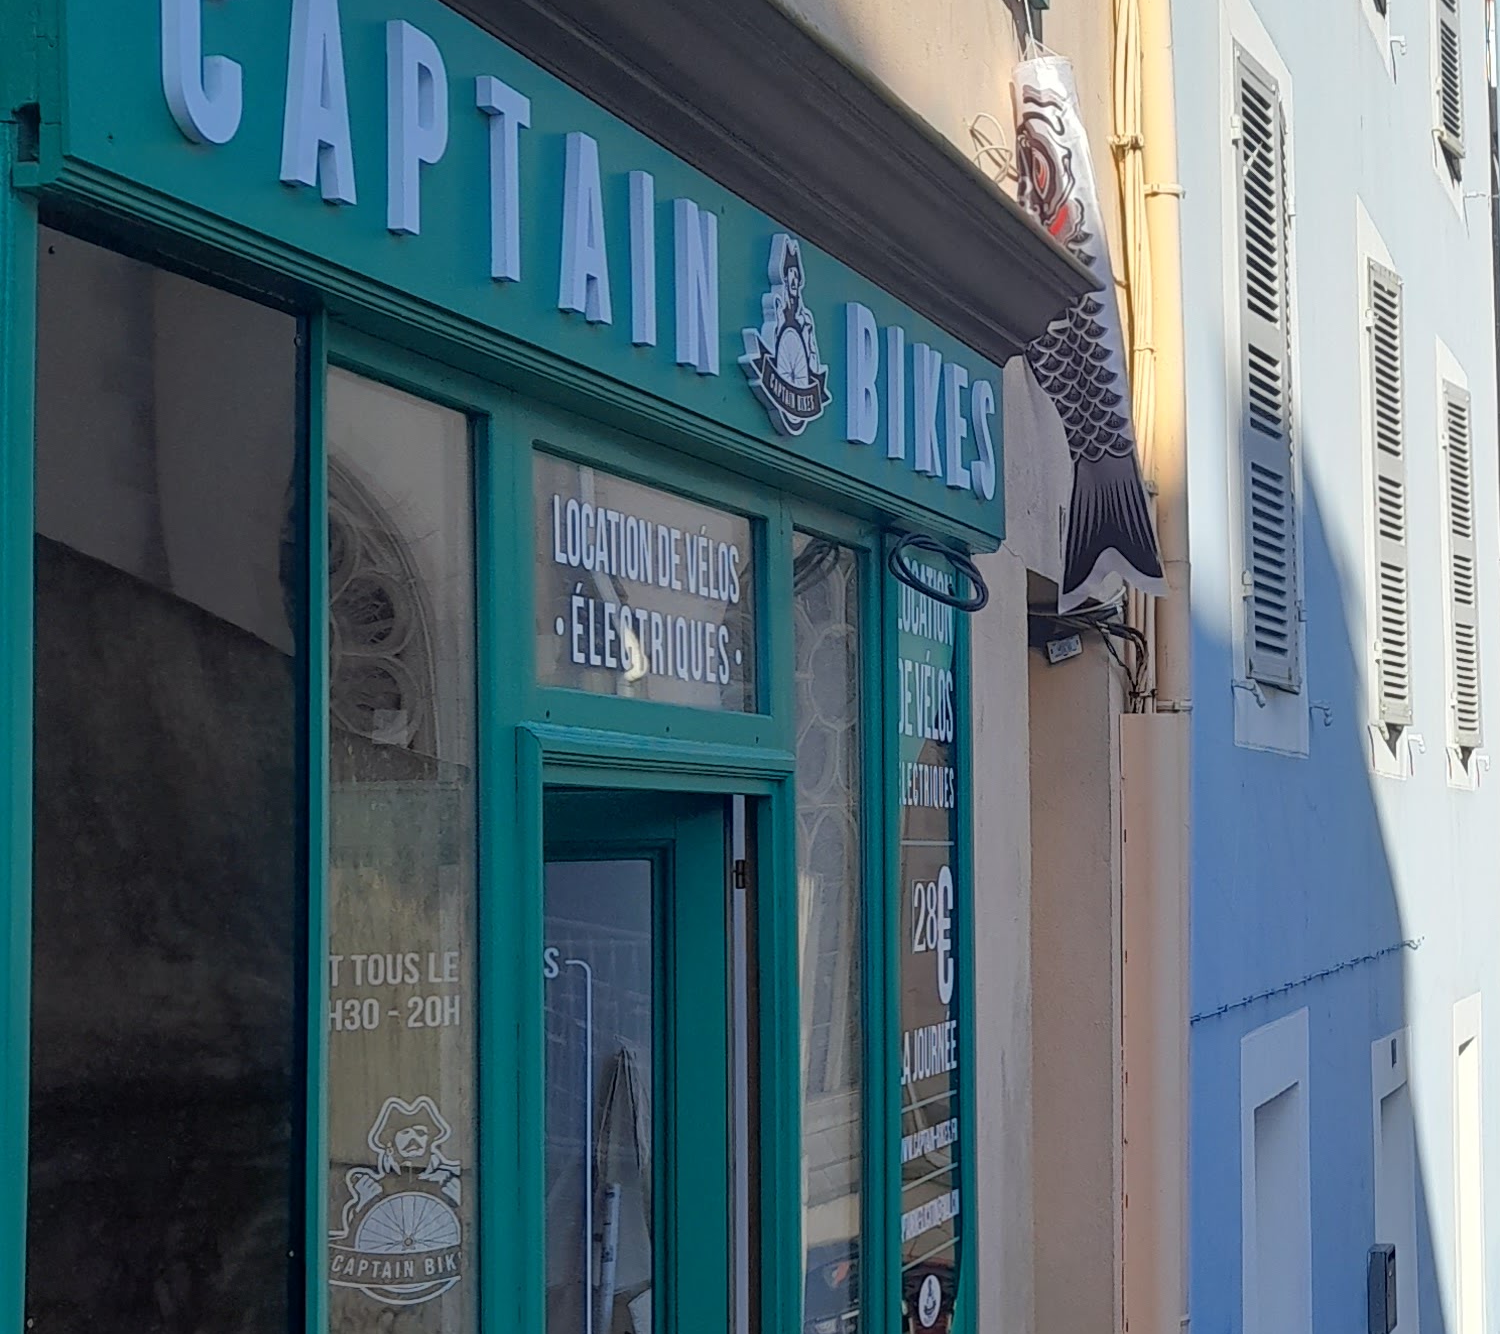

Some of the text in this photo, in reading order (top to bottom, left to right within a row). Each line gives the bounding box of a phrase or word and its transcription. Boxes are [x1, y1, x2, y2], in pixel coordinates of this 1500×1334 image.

[846, 302, 996, 501] BIKES
[553, 494, 740, 604] LOCATION DE VÉLOS
[571, 581, 730, 685] ÉLECTRIQUES
[915, 650, 954, 744] VÉLOS
[898, 762, 954, 809] LECTRIQUES
[350, 952, 420, 986] TOUS
[428, 951, 459, 983] LE
[407, 995, 460, 1028] 20H
[912, 1010, 957, 1082] JOURNÉE
[331, 1251, 462, 1279] CAPTAIN BIK
